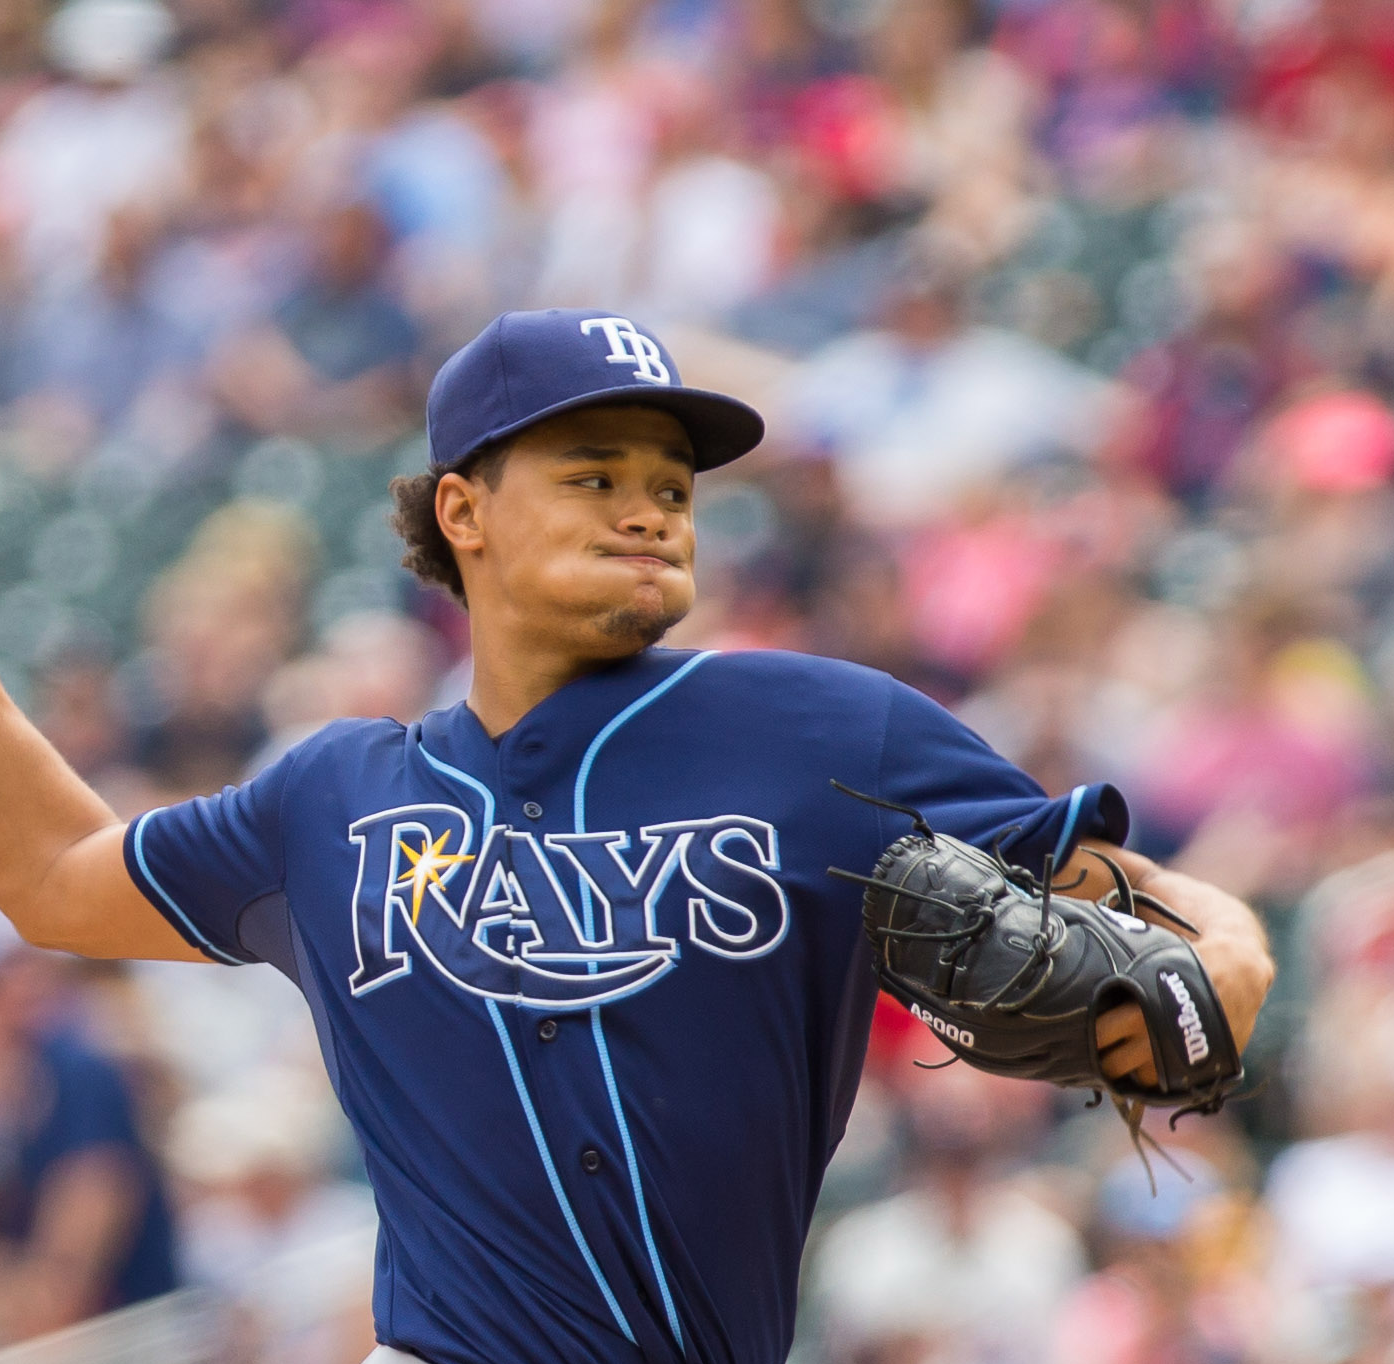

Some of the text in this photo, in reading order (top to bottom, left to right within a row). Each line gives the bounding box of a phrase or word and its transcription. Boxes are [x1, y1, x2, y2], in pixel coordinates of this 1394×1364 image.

[580, 317, 671, 386] TB
[347, 803, 791, 1010] RAYS
[910, 1002, 975, 1049] A2000
[1163, 971, 1209, 1066] Wilson
